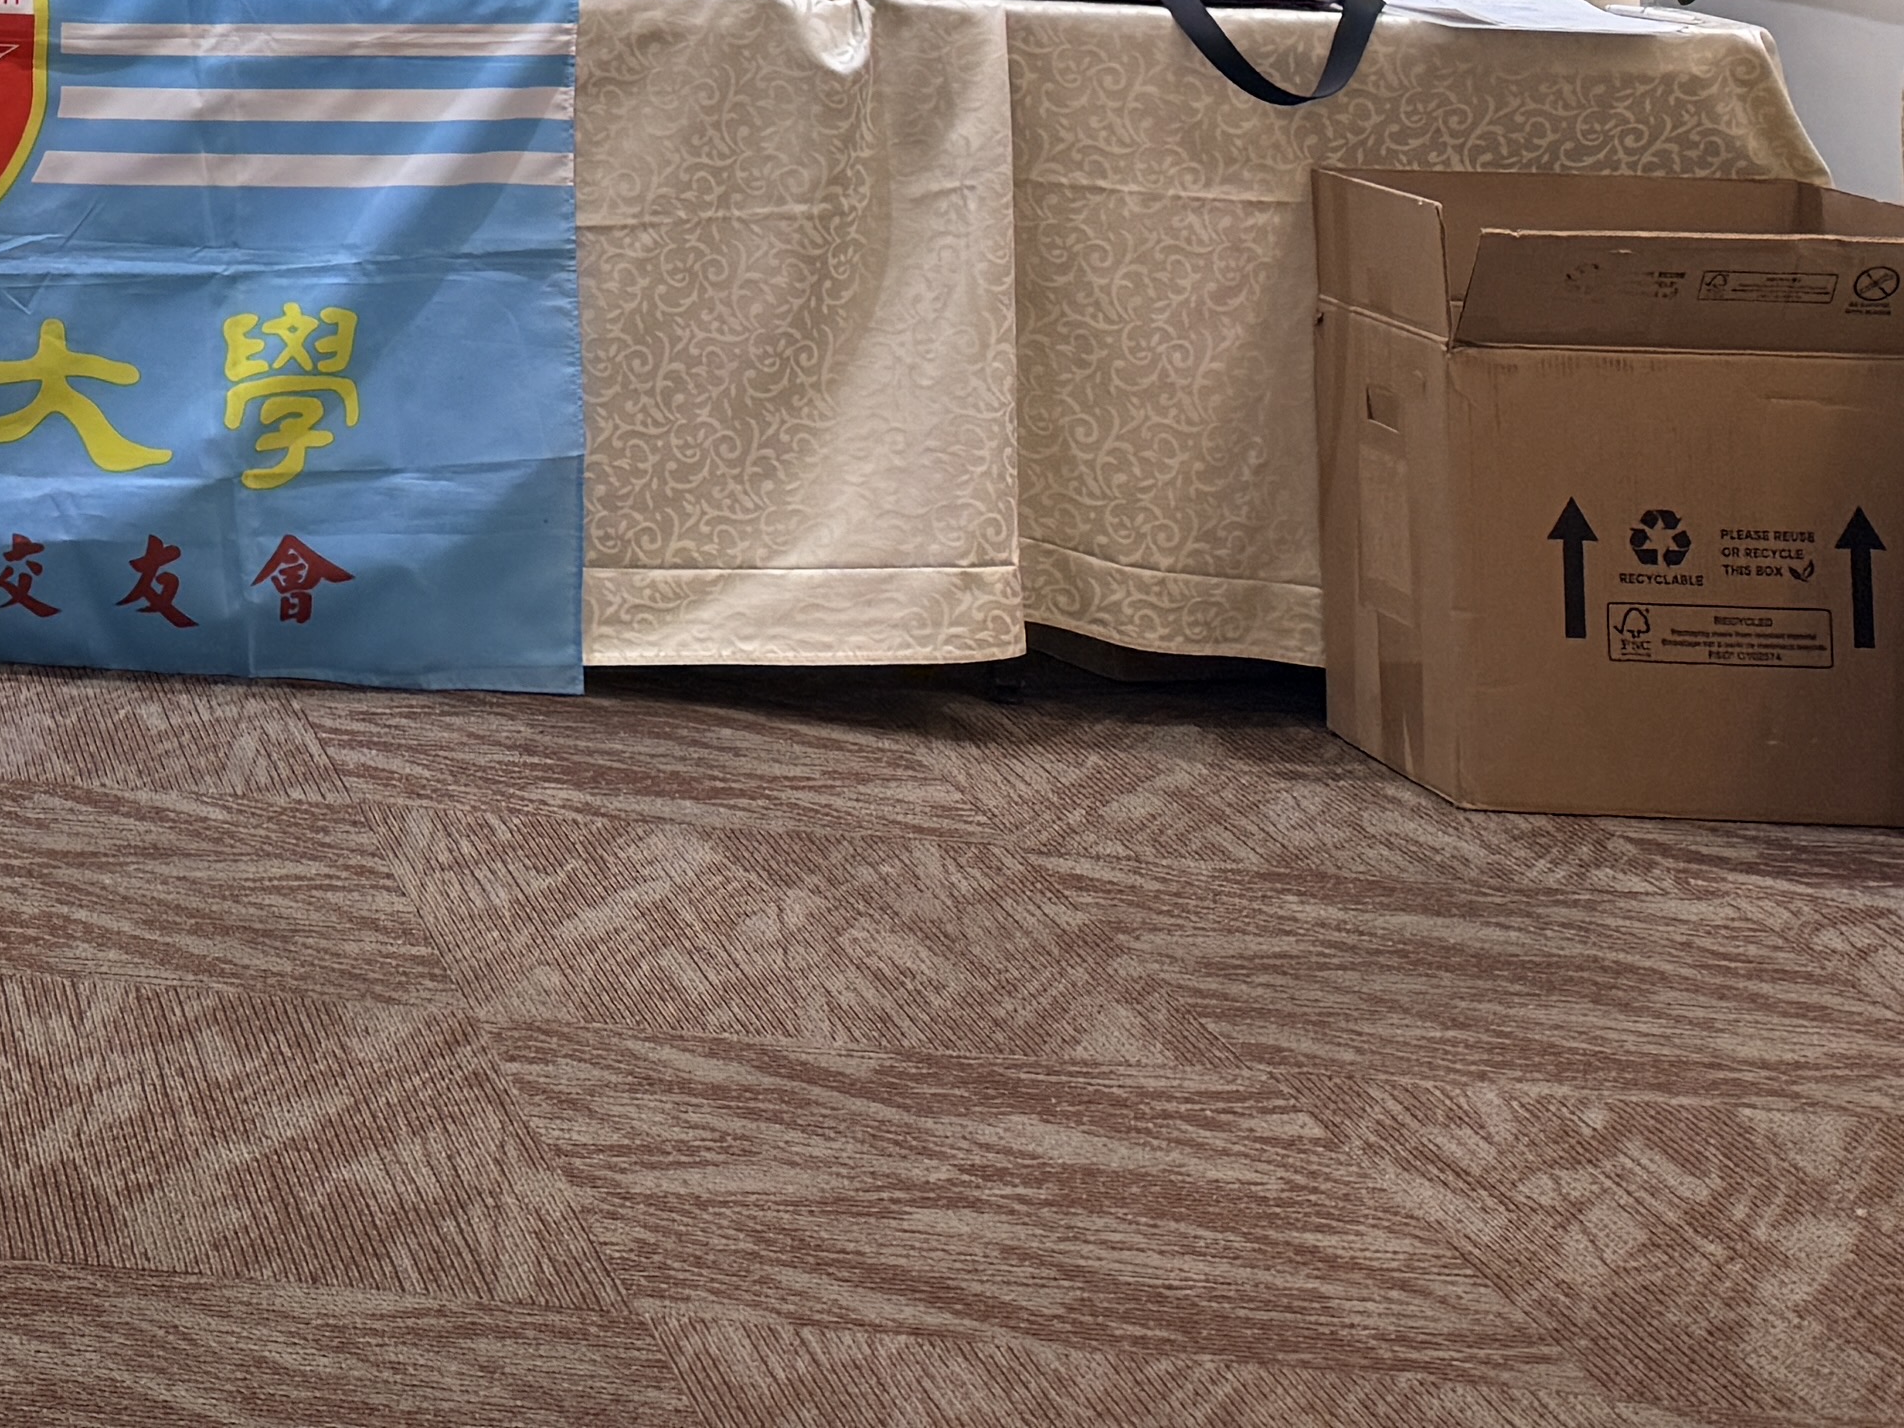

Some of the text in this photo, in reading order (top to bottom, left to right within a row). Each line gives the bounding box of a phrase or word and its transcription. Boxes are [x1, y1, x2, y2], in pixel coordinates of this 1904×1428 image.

[1720, 529, 1769, 542] PLEASE
[1721, 547, 1804, 560] OR RECYCLE
[1722, 564, 1783, 578] THIS BOX
[1619, 572, 1704, 586] RECYCLABLE
